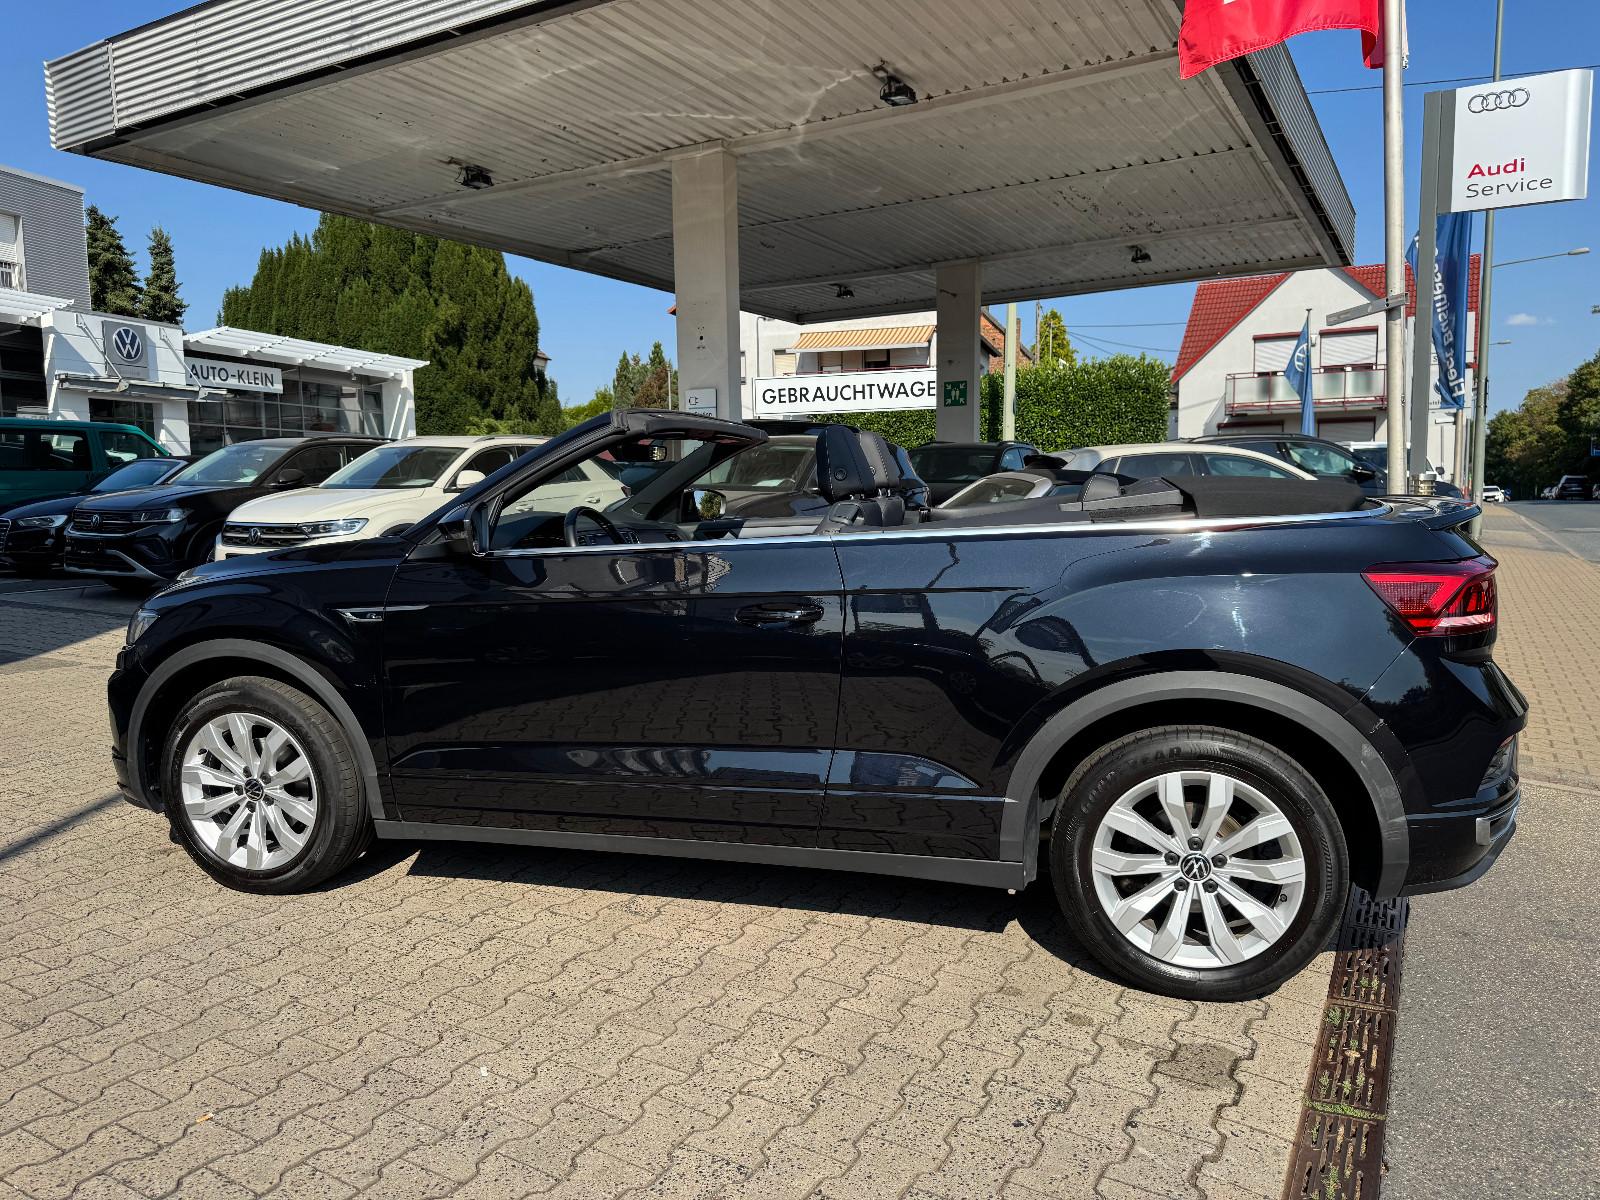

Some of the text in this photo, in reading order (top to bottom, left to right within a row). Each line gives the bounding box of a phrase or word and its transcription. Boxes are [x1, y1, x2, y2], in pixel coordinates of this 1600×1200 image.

[1467, 158, 1525, 179] Audi
[1466, 177, 1553, 198] Service
[189, 364, 274, 387] AUTO-KLEIN
[762, 381, 936, 405] GEBRAUCHTWAGE
